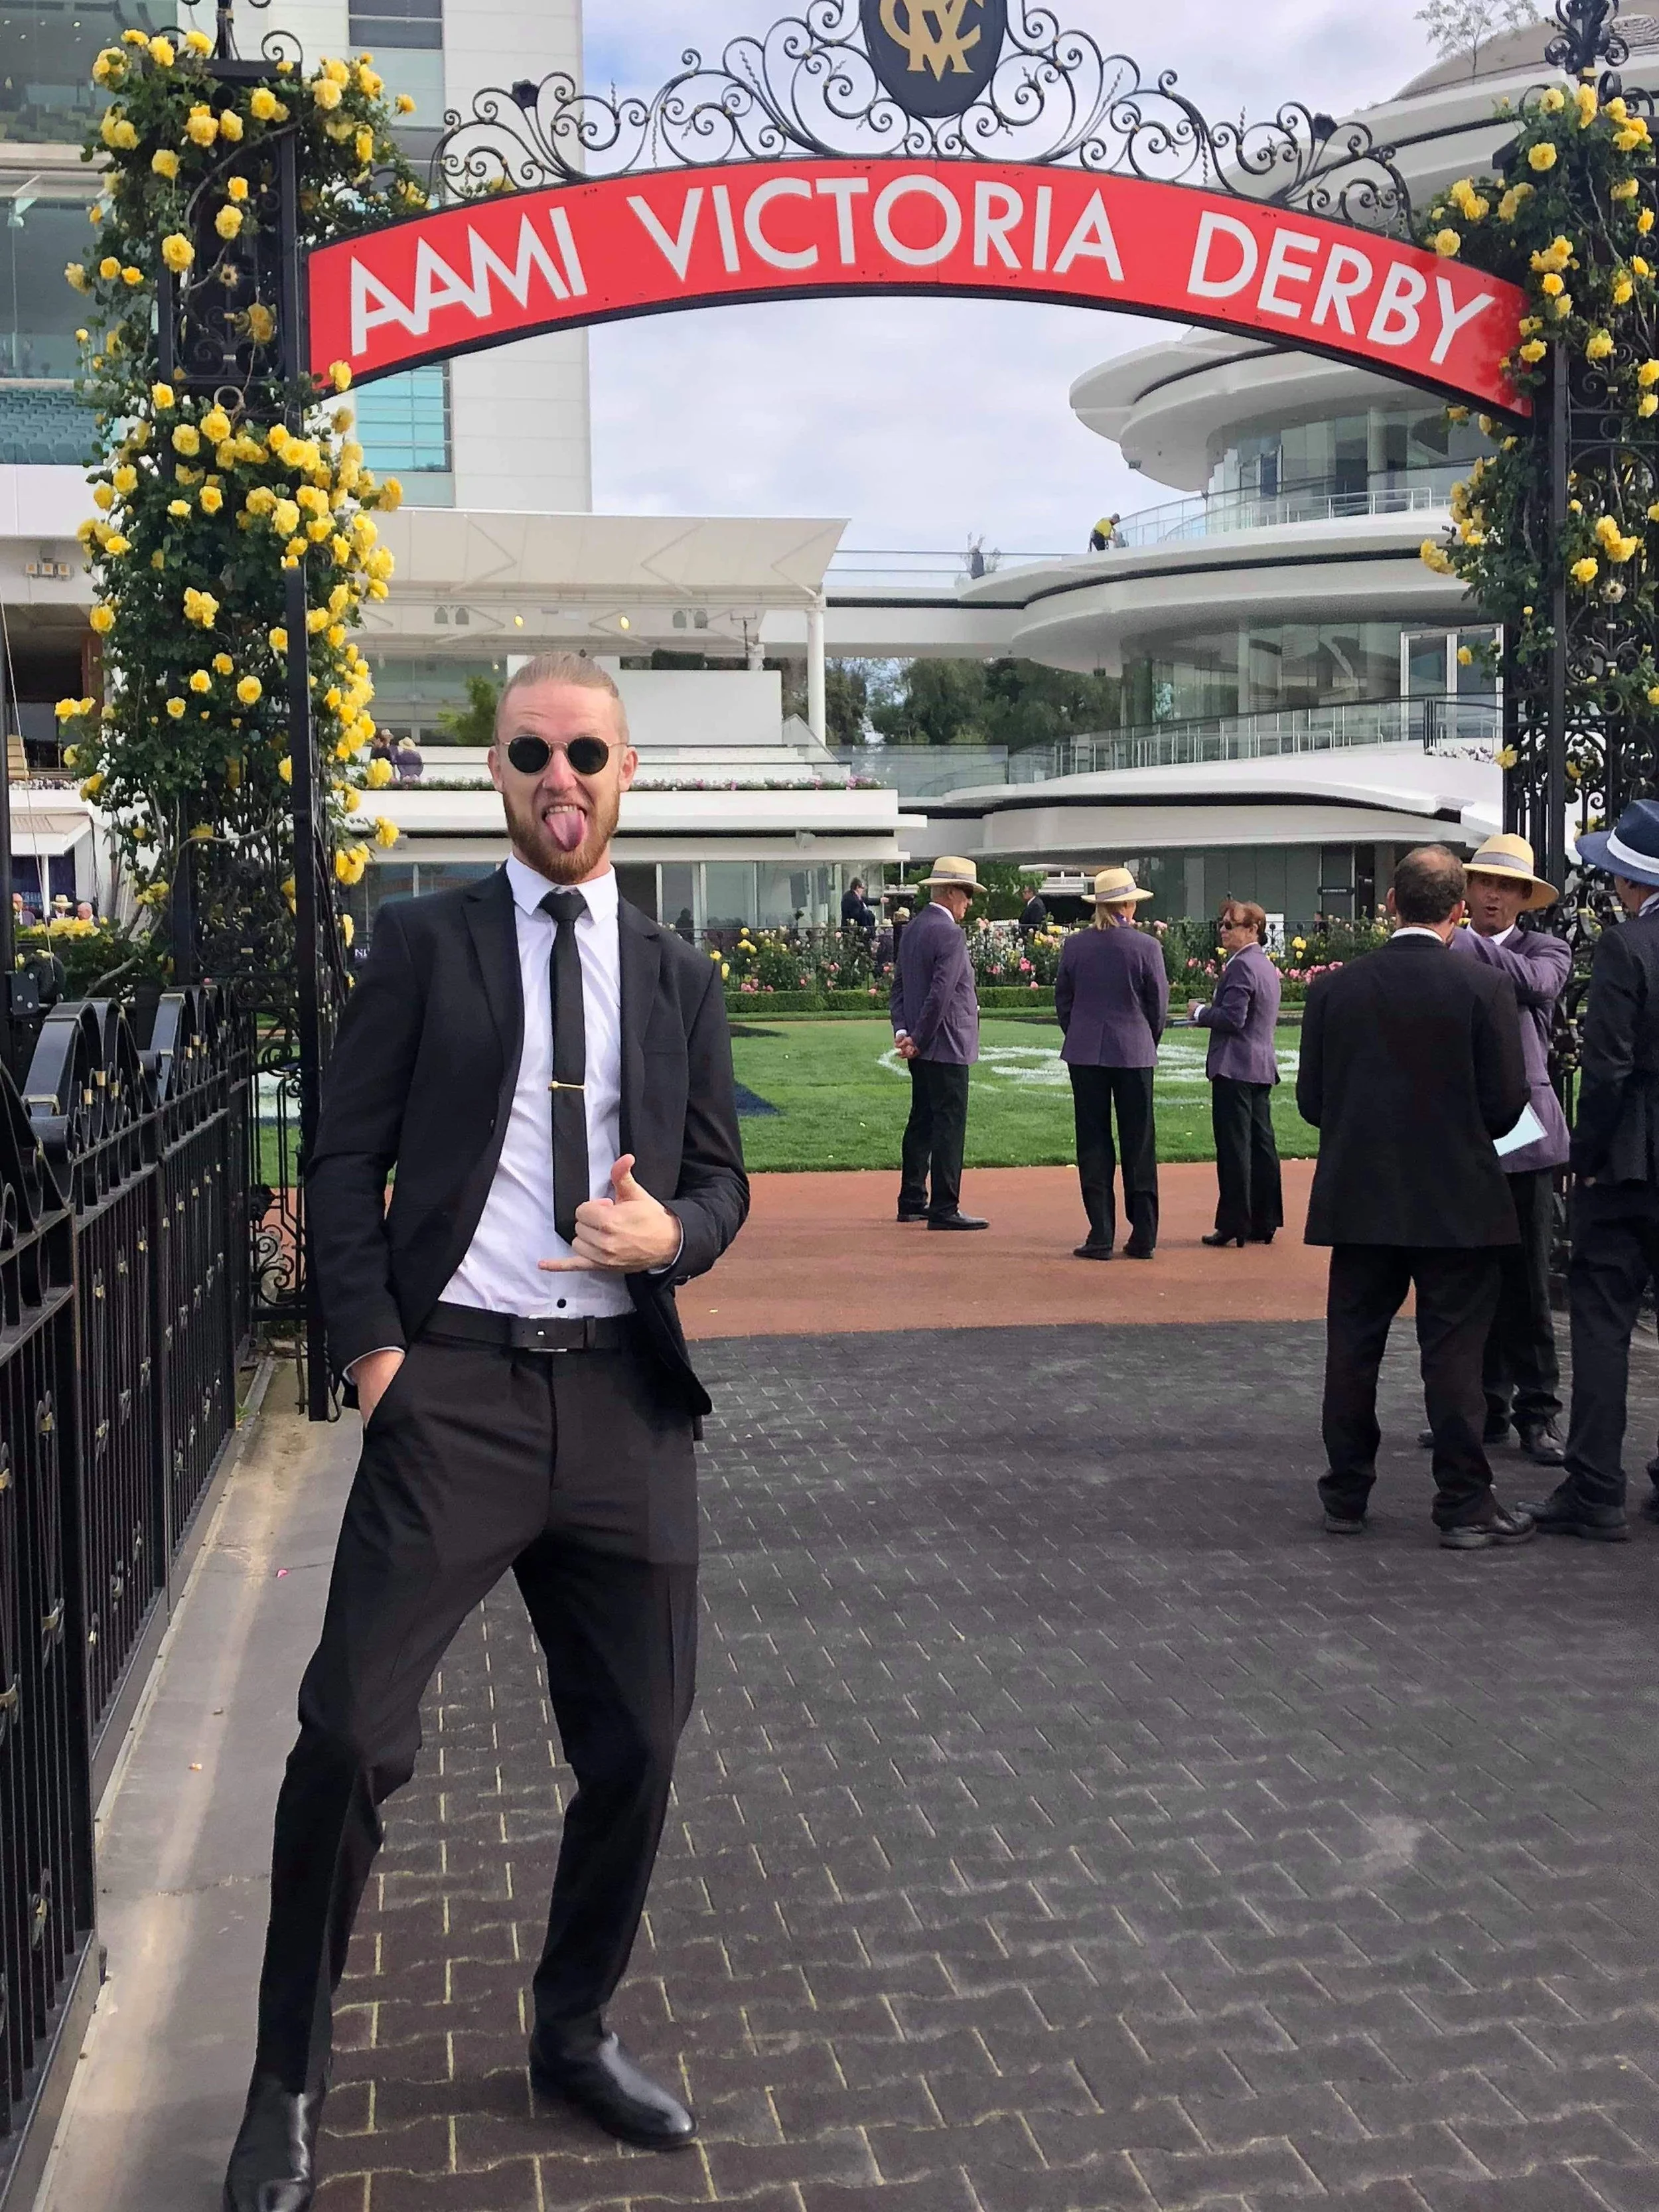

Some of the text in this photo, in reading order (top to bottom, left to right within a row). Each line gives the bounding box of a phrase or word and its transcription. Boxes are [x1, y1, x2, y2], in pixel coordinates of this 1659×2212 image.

[350, 175, 1494, 365] AAMI VICTORIA DERBY
